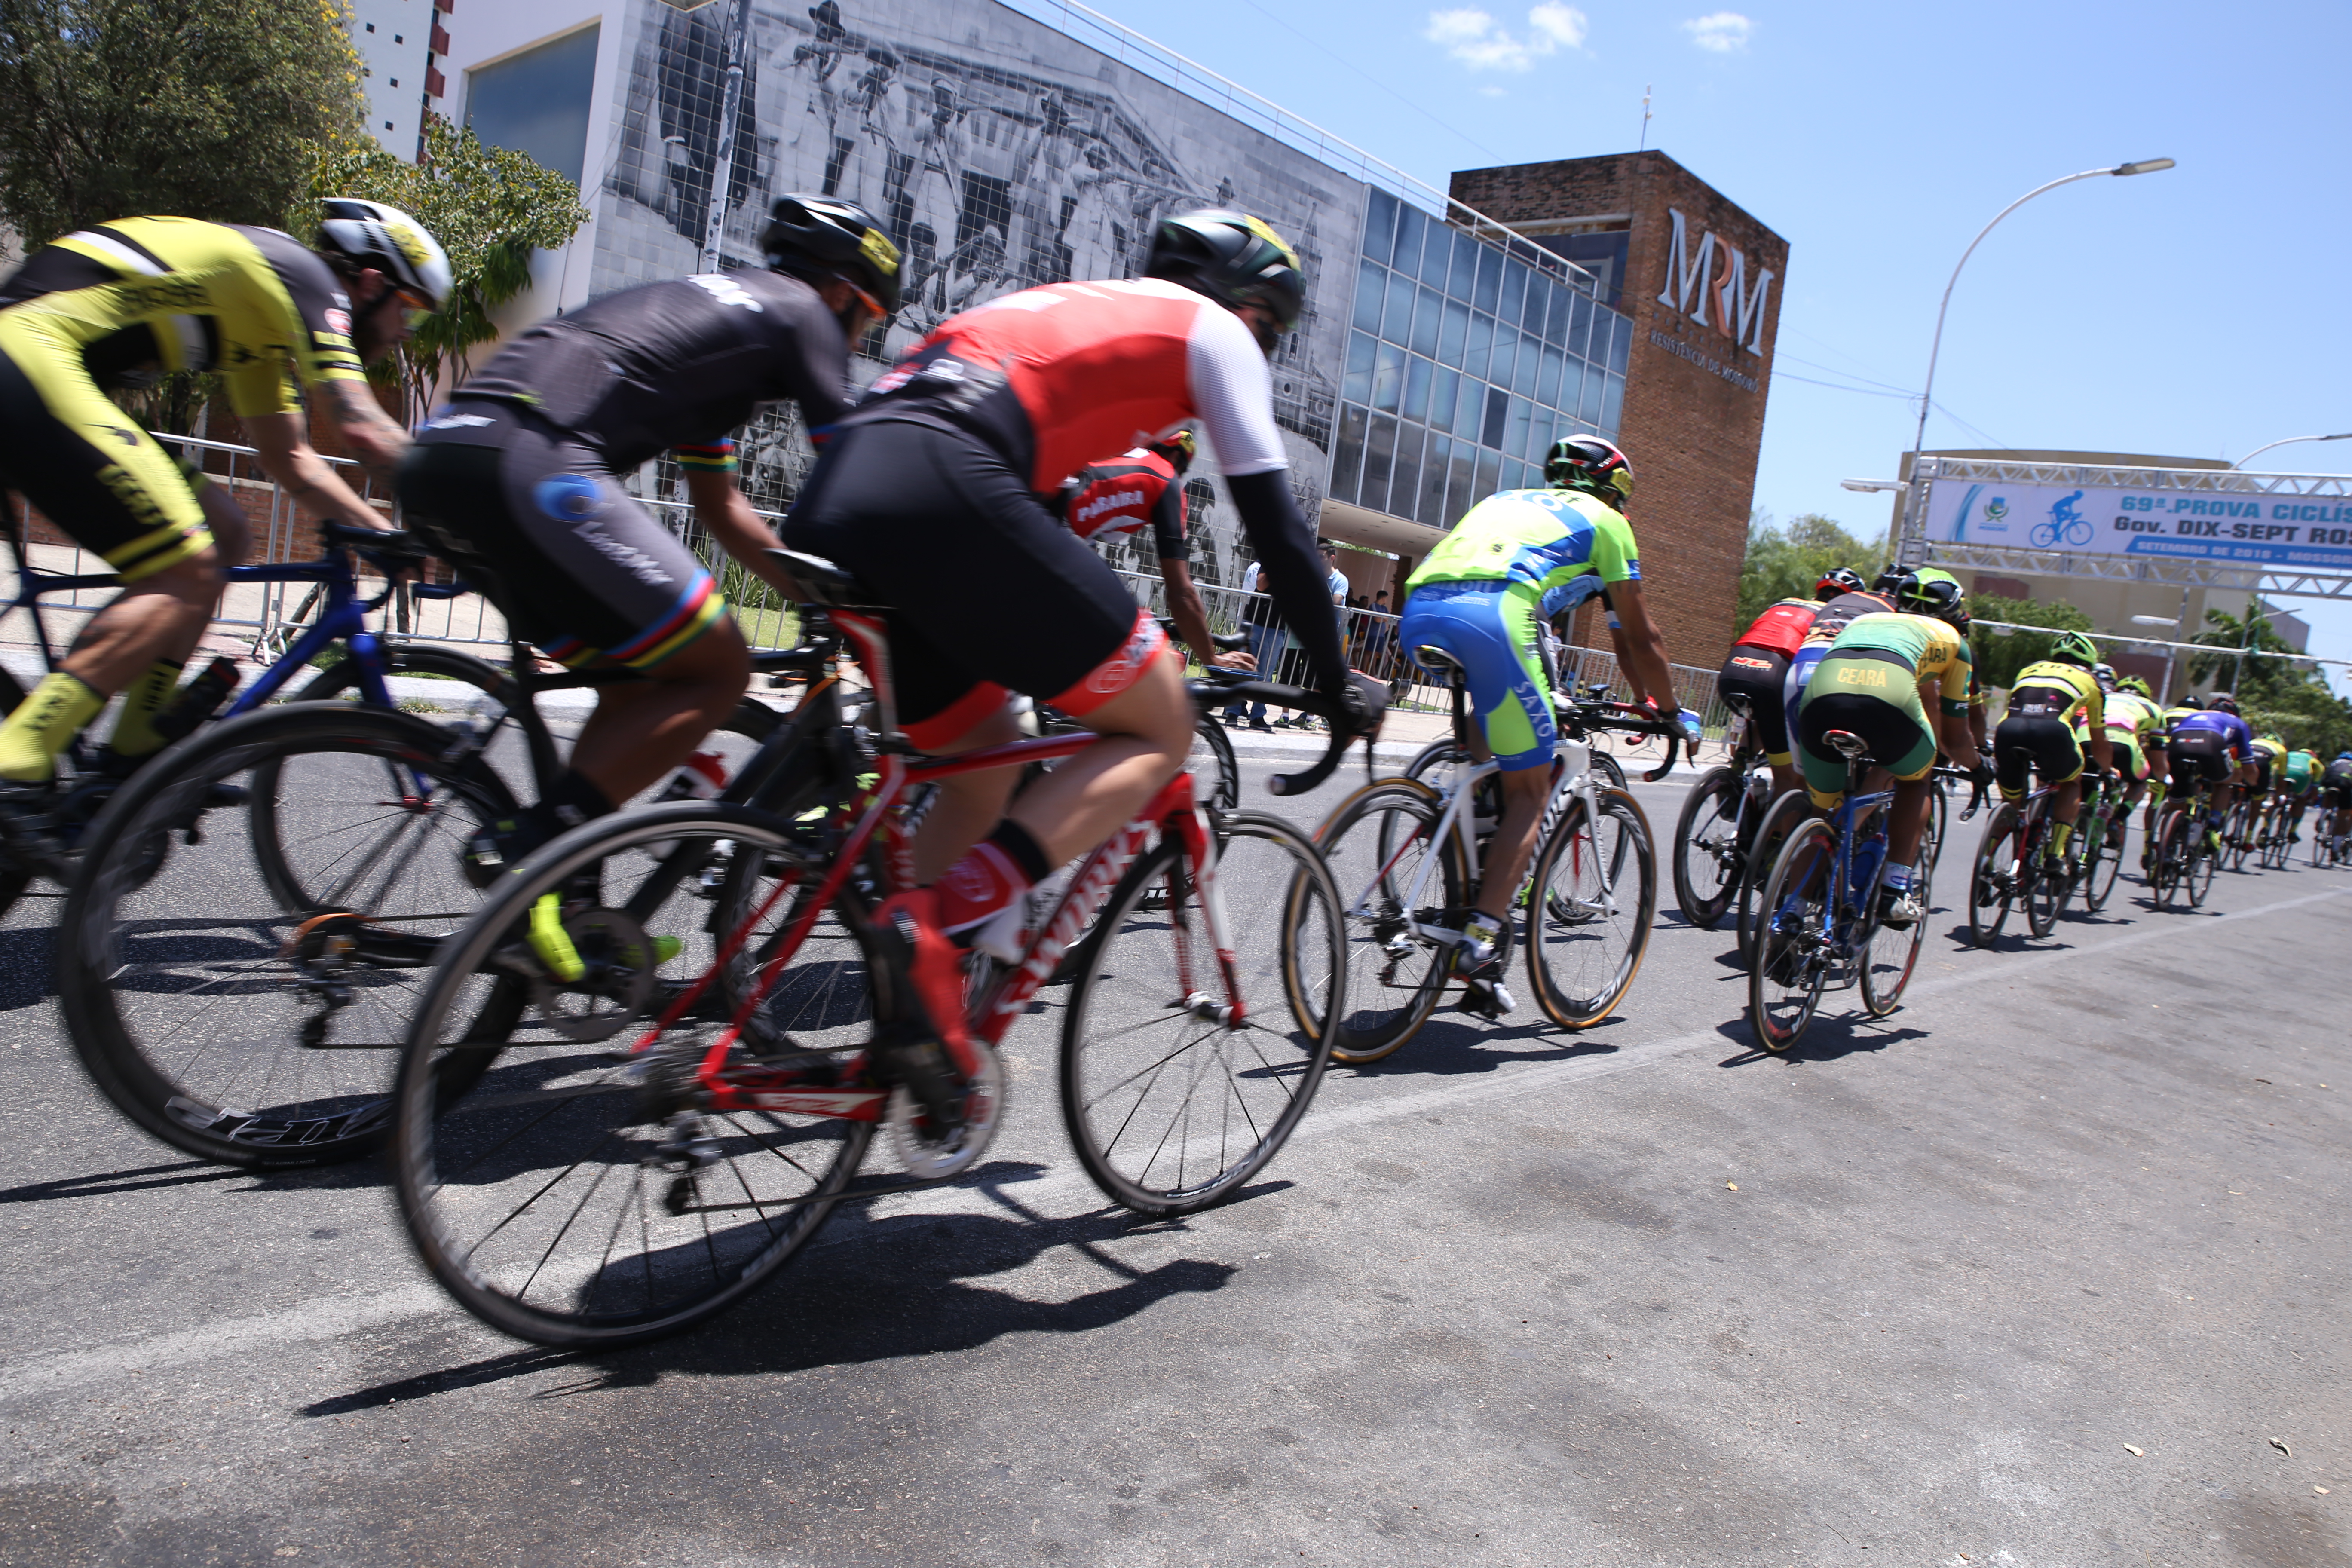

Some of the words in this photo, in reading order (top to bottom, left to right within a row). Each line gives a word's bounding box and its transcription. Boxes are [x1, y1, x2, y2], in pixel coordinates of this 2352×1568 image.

[1657, 207, 1775, 358] MRM
[2114, 516, 2167, 533] Gov.
[2177, 519, 2300, 542] DIX-SEPT
[2309, 527, 2352, 545] RO
[2137, 541, 2208, 555] SETEMBRO
[2211, 546, 2230, 556] DE
[1837, 668, 1886, 687] CEARÁ
[1513, 681, 1553, 737] SAXO
